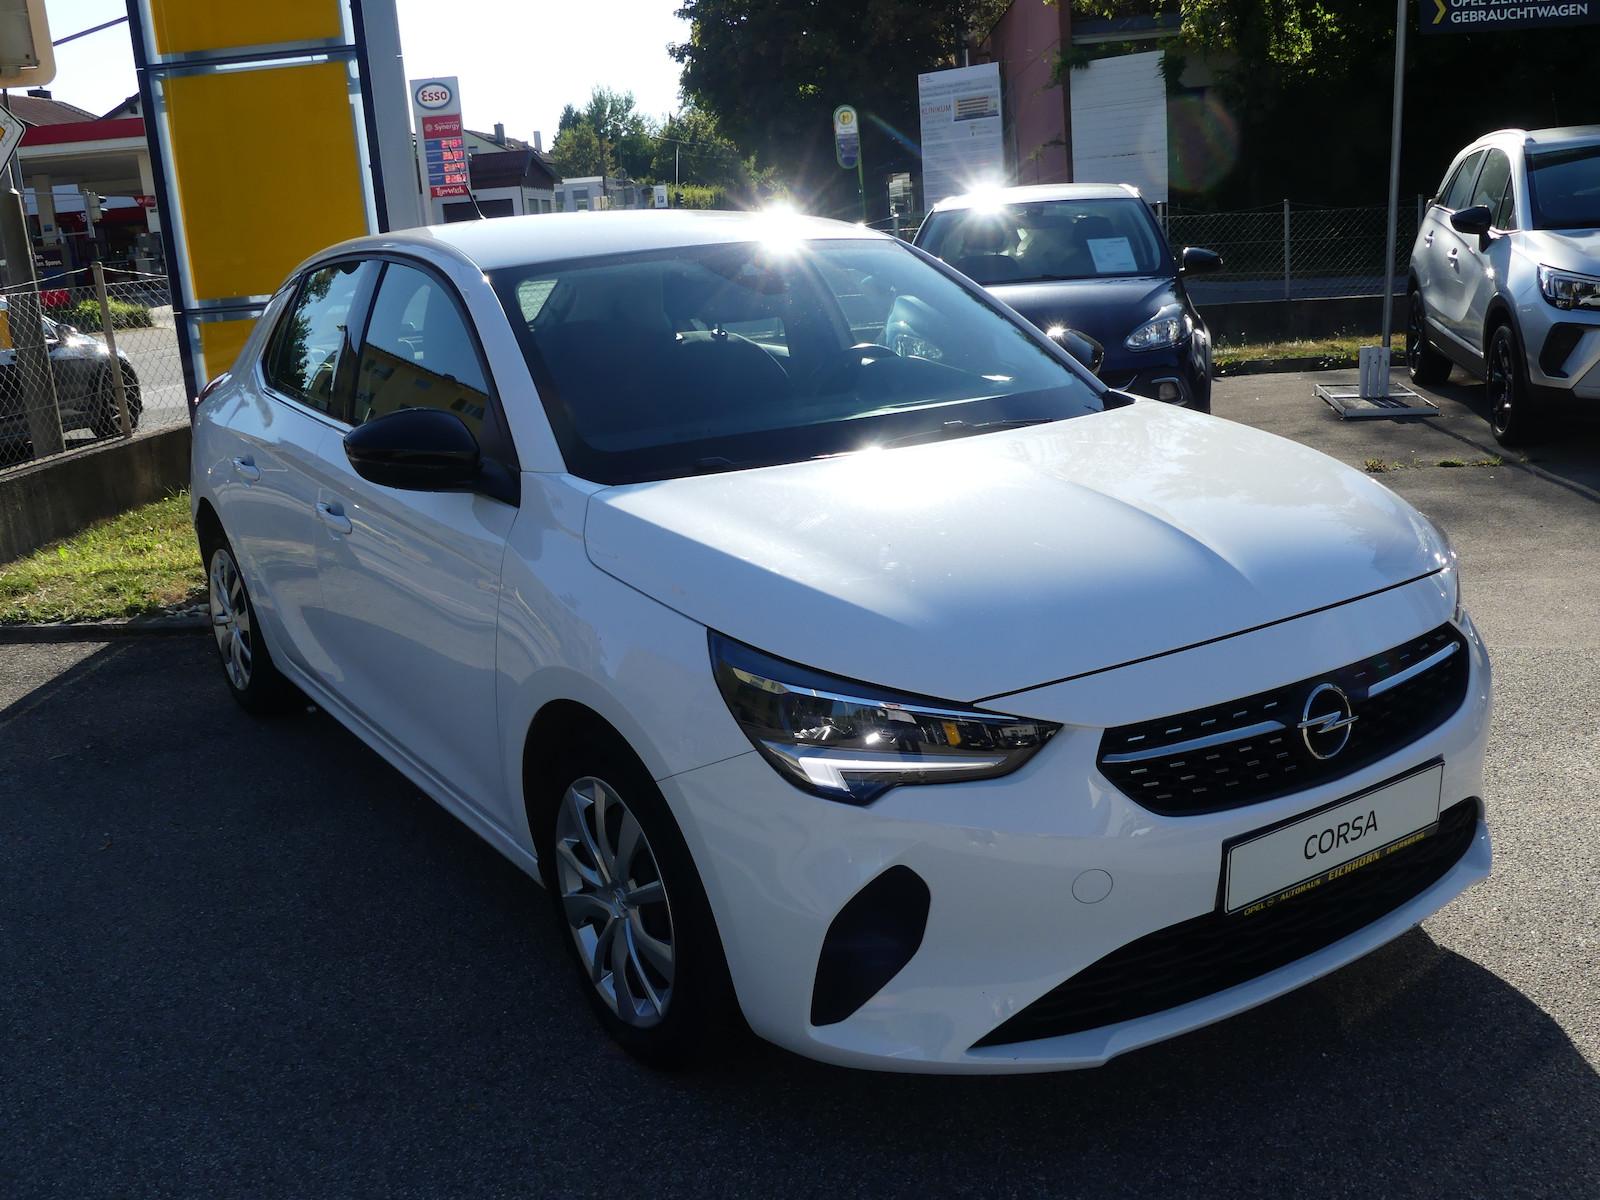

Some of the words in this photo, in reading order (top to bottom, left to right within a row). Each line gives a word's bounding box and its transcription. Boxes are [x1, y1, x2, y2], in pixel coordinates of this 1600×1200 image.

[1450, 3, 1588, 24] GEBRAUCHTWAGEN
[434, 122, 460, 132] Synergy
[1303, 810, 1378, 860] CORSA
[1243, 902, 1266, 916] OPEL
[1279, 878, 1321, 901] AUTOHAUS
[1327, 850, 1381, 881] EICHHORN
